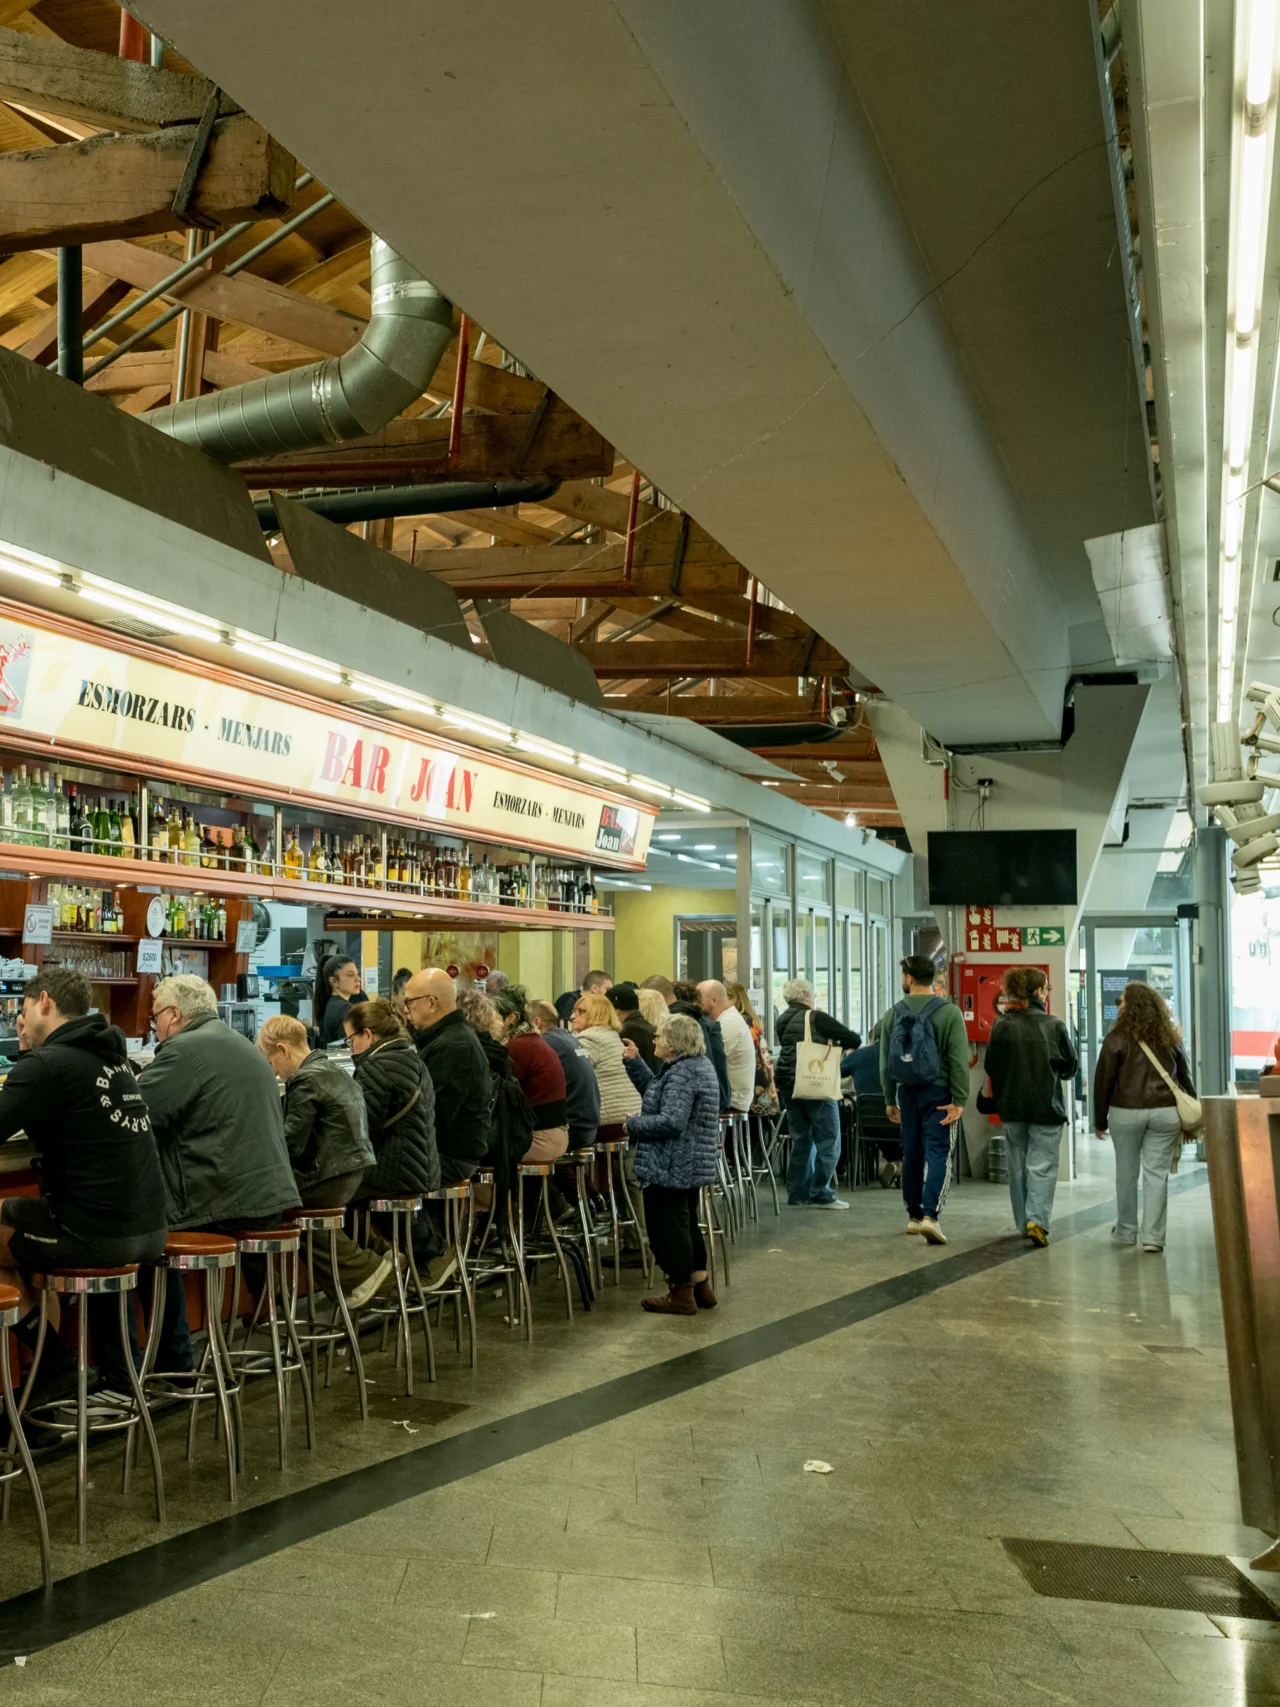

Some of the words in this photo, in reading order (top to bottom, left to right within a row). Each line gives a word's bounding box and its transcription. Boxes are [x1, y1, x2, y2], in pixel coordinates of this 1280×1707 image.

[77, 679, 196, 733] ESMORZARS
[218, 717, 293, 757] MENJARS
[319, 731, 391, 794] BAR
[493, 791, 543, 819] ESMORZARS
[551, 806, 586, 830] MENJARS
[600, 807, 622, 831] BA
[596, 828, 620, 851] Joan
